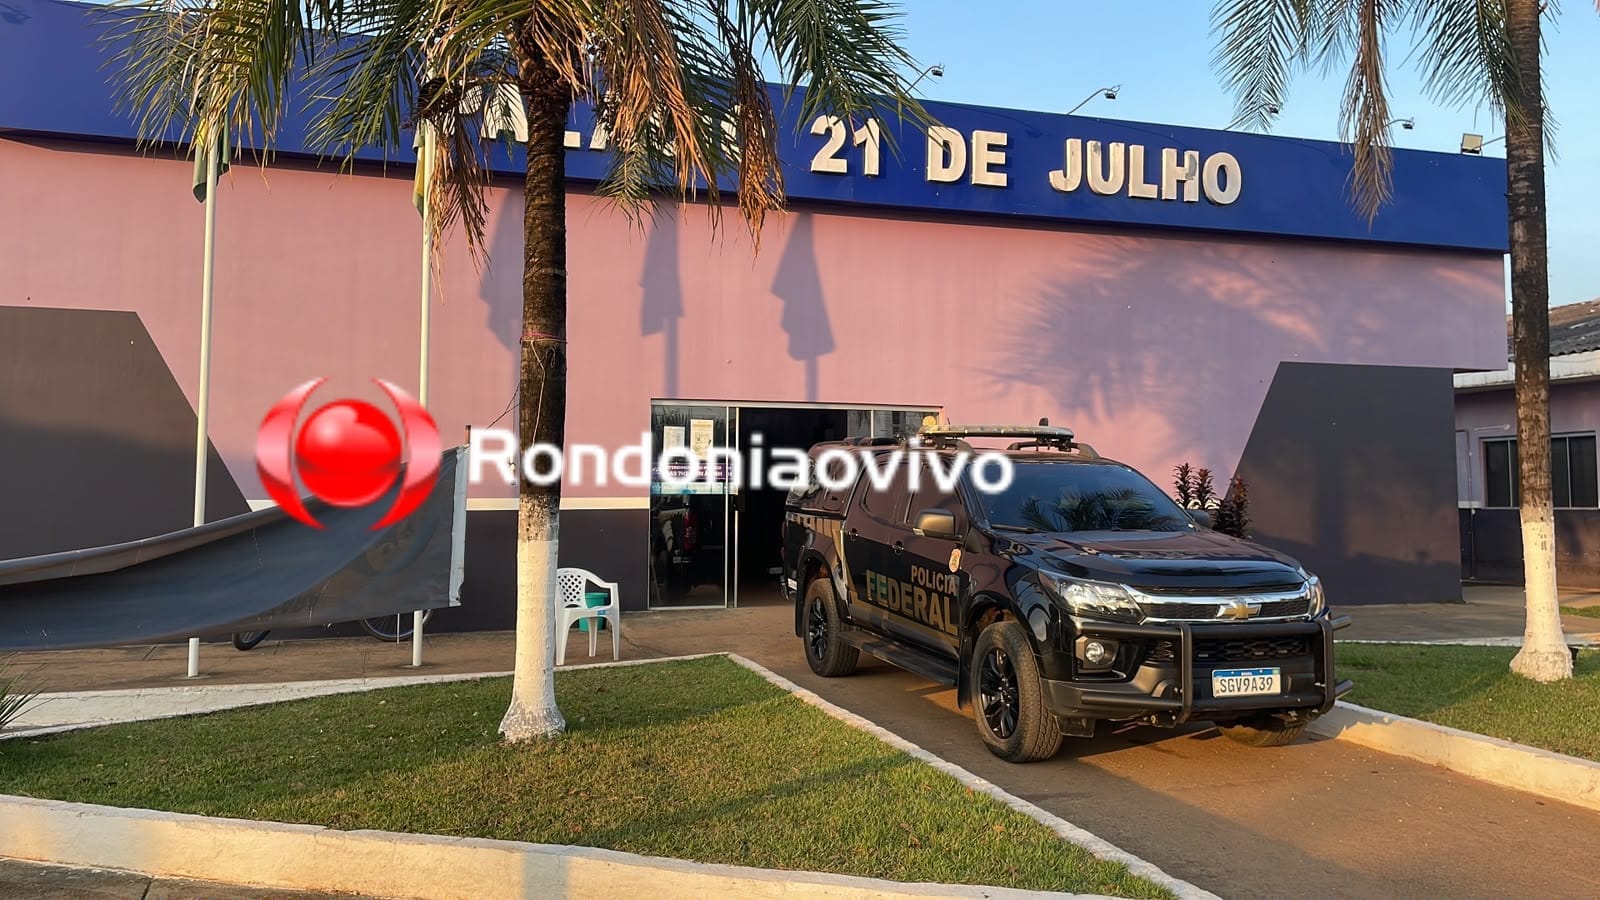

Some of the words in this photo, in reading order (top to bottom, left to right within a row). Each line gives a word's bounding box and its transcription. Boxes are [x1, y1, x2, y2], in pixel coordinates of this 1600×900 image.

[809, 114, 881, 176] 21
[926, 125, 1008, 186] DE
[1048, 138, 1242, 205] JULHO
[865, 569, 959, 636] FEDERAL
[1220, 676, 1273, 693] SGV9A39
